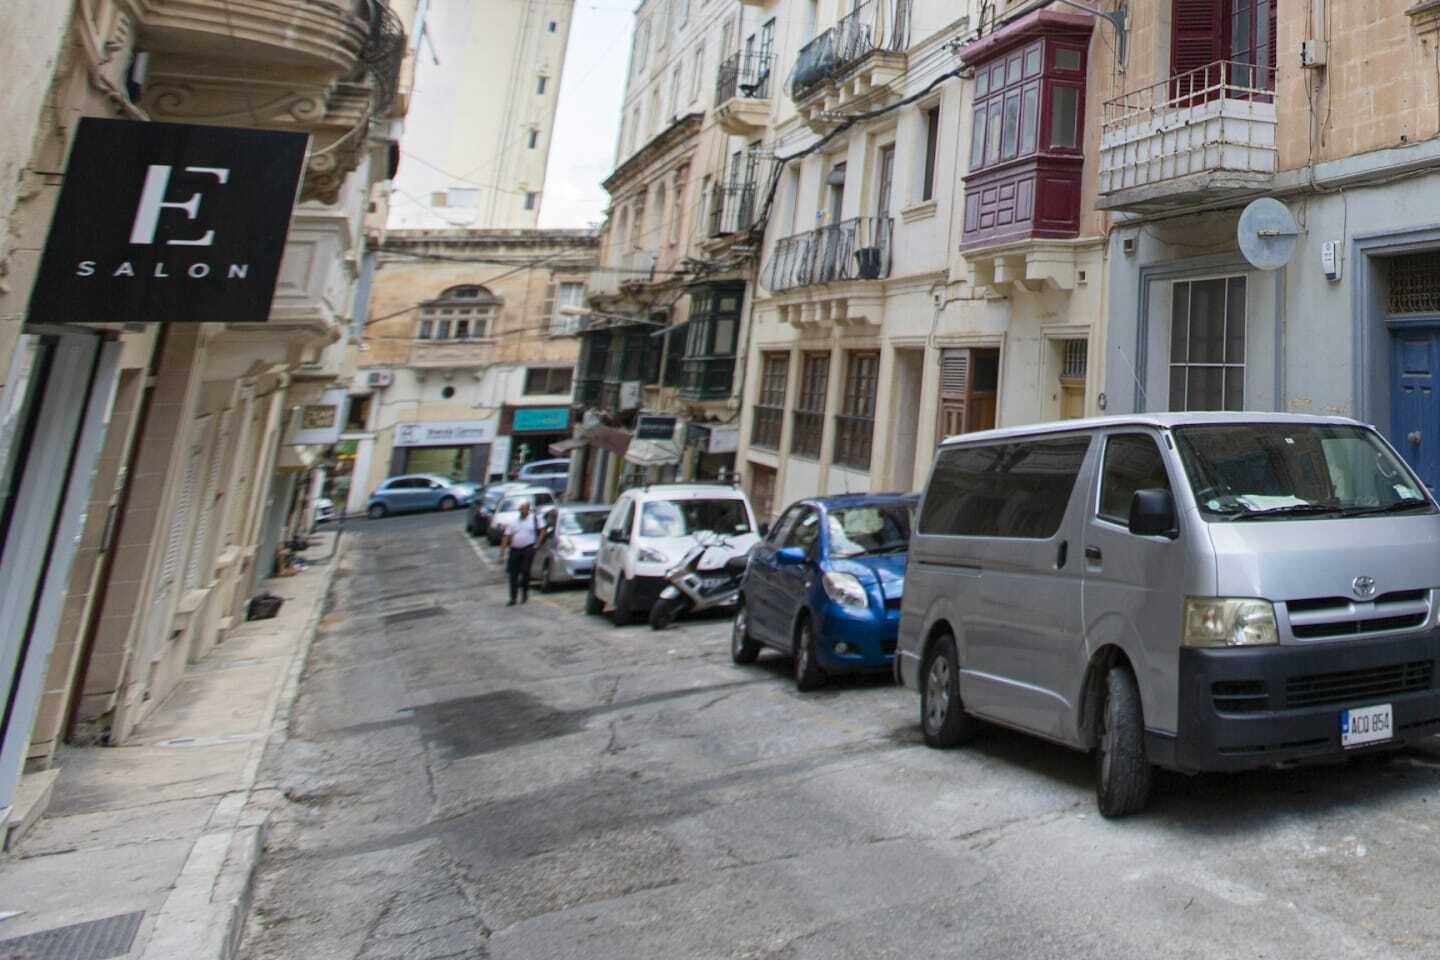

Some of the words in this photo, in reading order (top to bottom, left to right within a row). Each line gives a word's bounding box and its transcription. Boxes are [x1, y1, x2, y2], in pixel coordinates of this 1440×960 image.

[129, 164, 231, 246] E
[76, 260, 249, 279] SALON
[1373, 712, 1389, 732] 854
